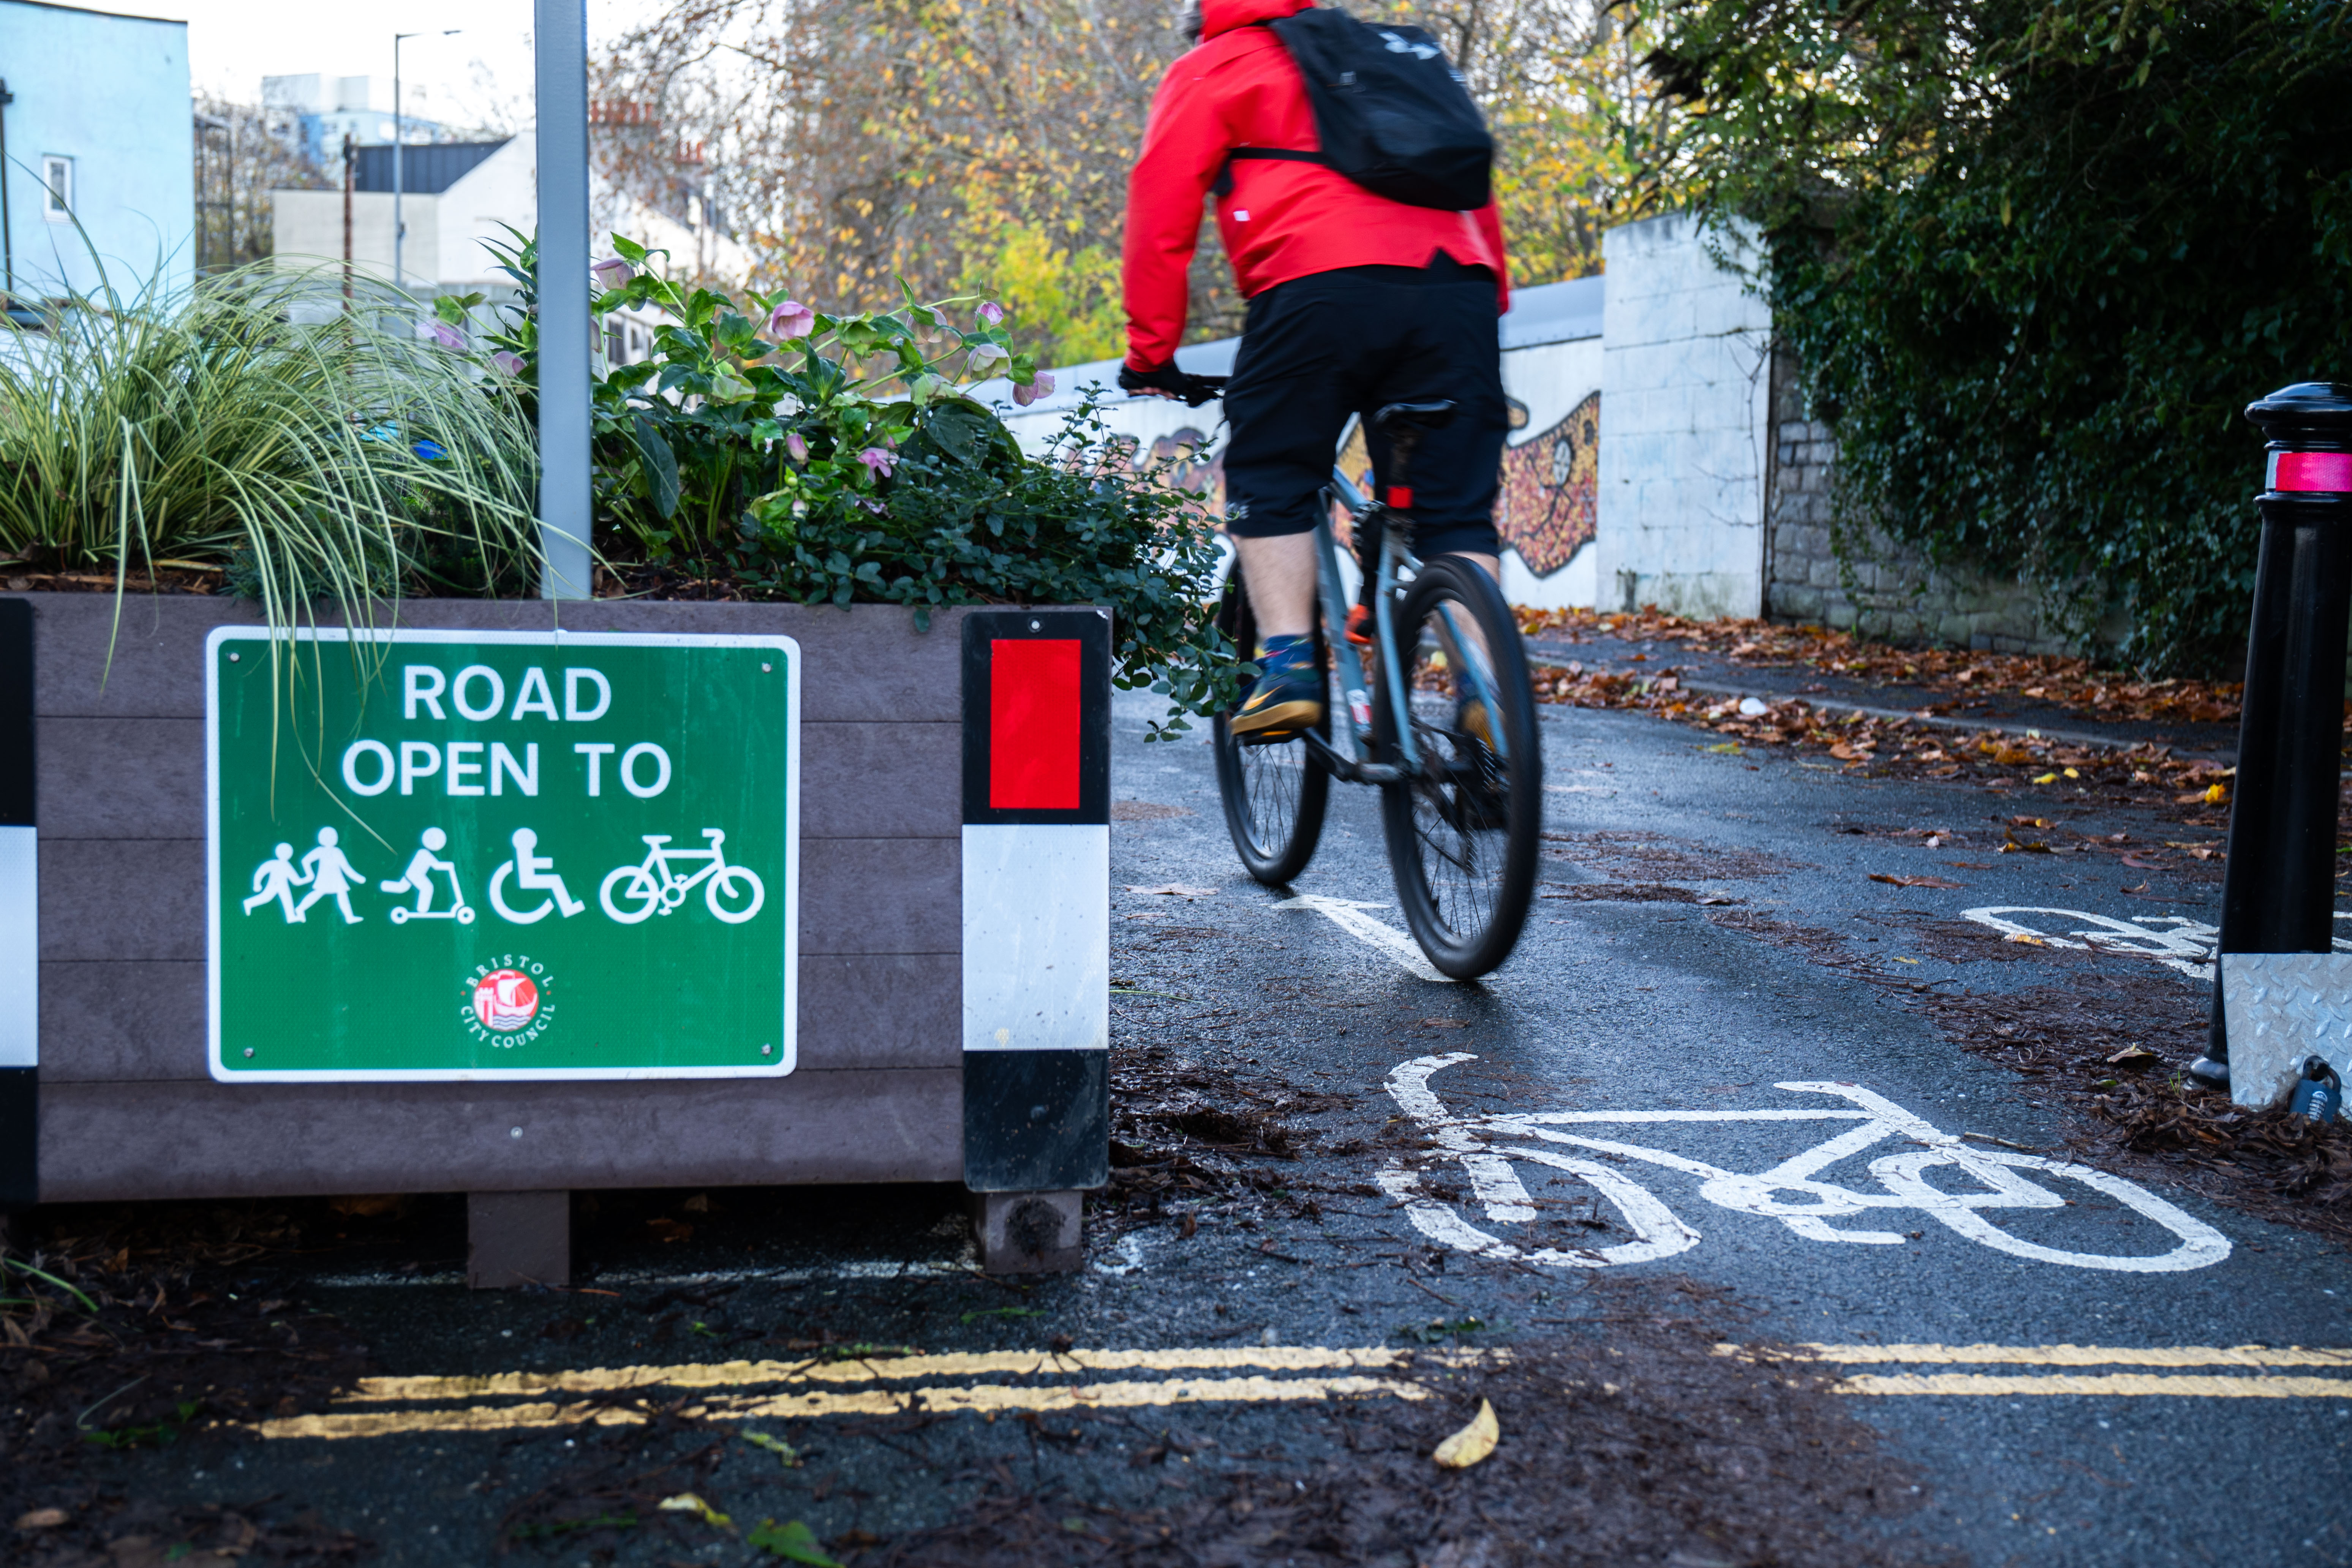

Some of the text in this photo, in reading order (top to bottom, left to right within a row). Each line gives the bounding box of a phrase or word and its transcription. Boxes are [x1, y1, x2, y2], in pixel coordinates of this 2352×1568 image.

[405, 665, 611, 721] ROAD
[343, 740, 671, 798] OPEN TO
[466, 954, 554, 988] BRISTOL
[461, 1004, 555, 1048] CITY COUNCIL
